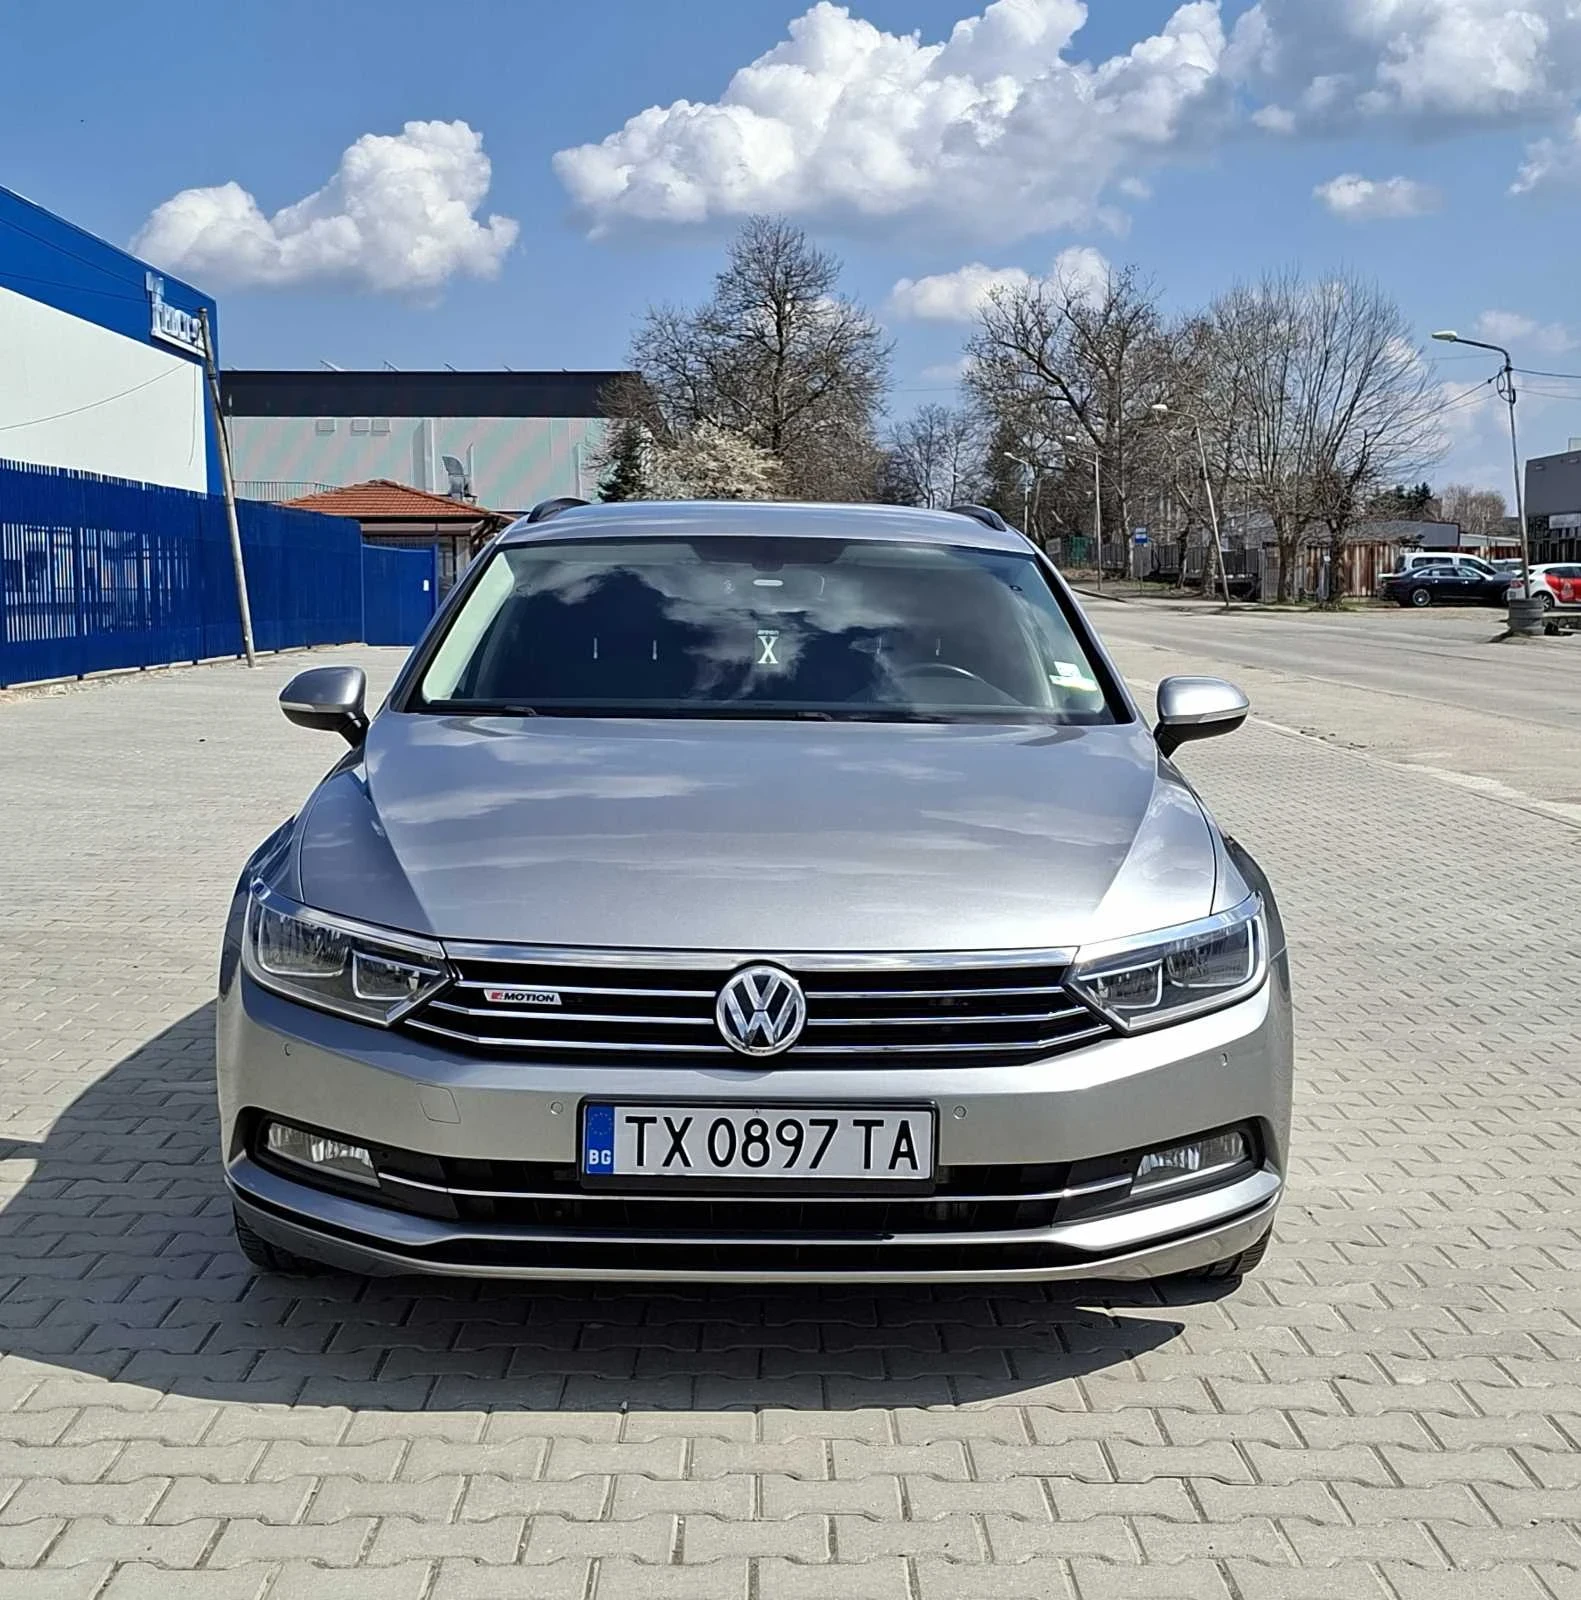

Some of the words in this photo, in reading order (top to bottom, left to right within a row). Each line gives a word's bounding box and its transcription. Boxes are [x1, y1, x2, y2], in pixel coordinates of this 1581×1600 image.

[721, 971, 799, 1048] VW
[588, 1149, 612, 1166] BG
[625, 1116, 693, 1168] TX
[707, 1117, 839, 1170] 0897
[852, 1118, 919, 1171] TA
